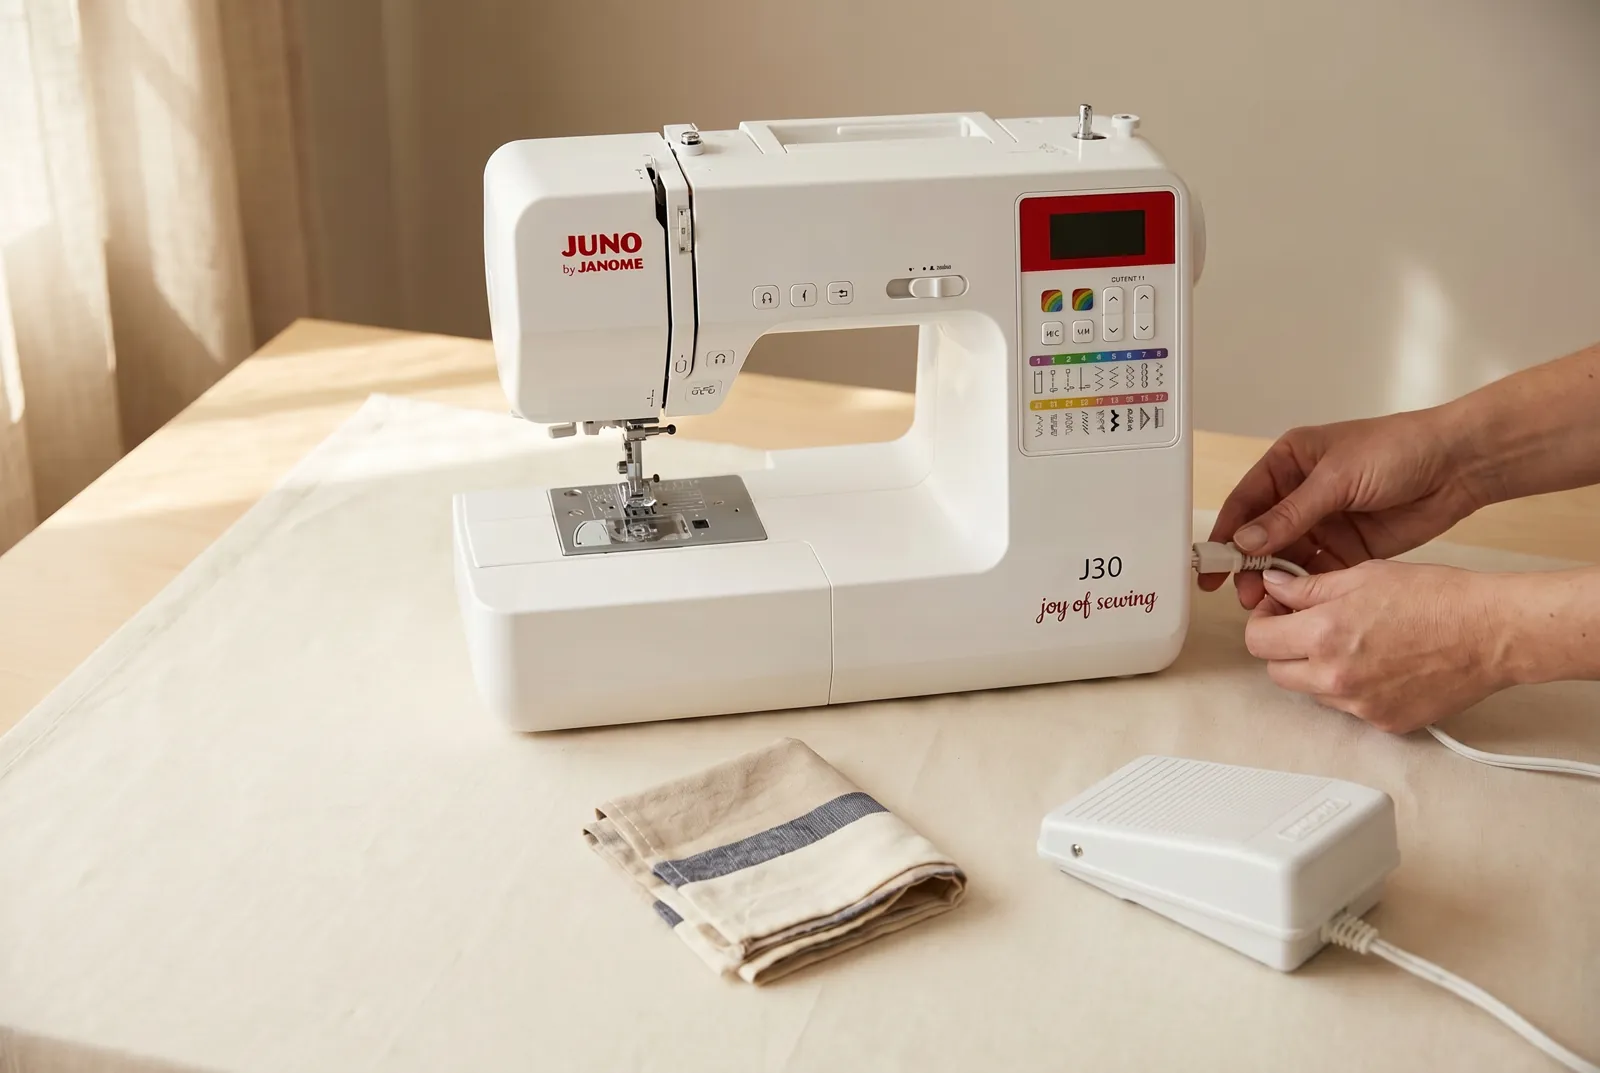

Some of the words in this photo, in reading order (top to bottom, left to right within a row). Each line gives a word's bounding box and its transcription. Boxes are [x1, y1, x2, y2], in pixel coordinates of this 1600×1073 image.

[561, 232, 642, 257] JUNO
[563, 264, 575, 276] by
[578, 258, 644, 273] JANOME
[1066, 355, 1072, 363] 2
[1081, 354, 1087, 362] 4
[1126, 351, 1132, 359] 6
[1079, 556, 1122, 580] J30
[1035, 598, 1069, 624] joy
[1072, 591, 1092, 619] of
[1096, 590, 1159, 613] sewing
